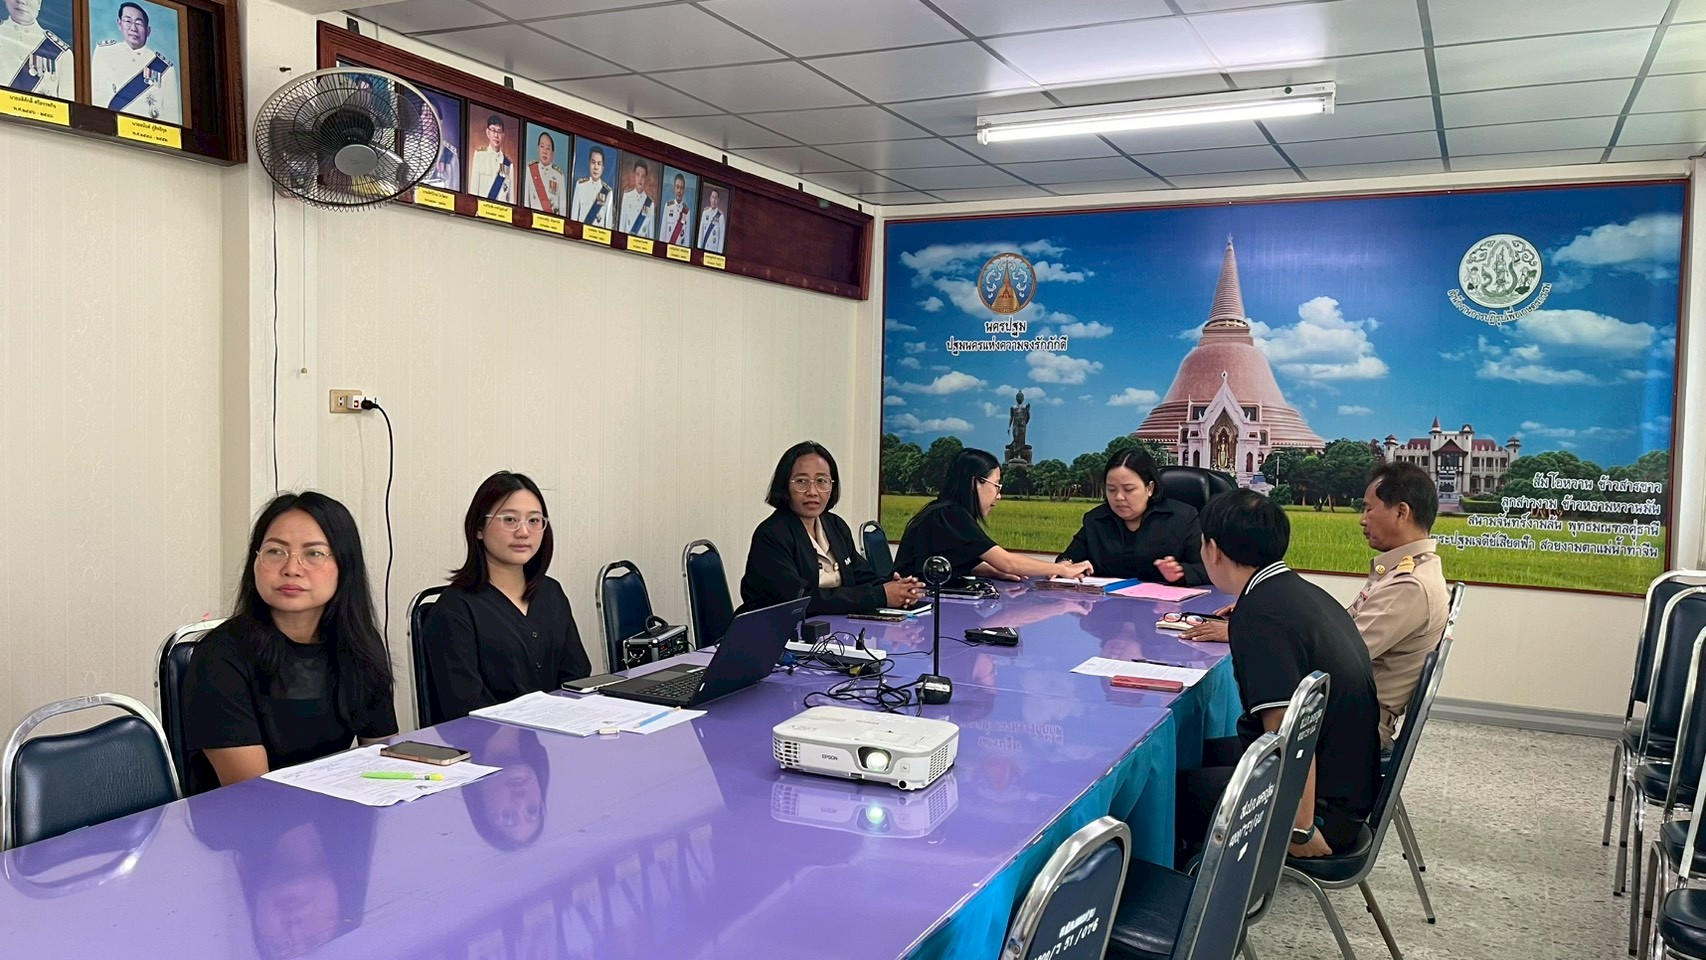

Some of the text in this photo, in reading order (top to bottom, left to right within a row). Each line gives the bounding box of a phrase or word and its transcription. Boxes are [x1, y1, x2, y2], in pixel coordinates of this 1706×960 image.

[985, 315, 1027, 337] นครปฐม
[946, 336, 1068, 355] ปฐมนครแห่งความจงรักภักดี
[1533, 471, 1662, 493] ส้มโอหวาน ข้าวสารขาว
[1501, 494, 1661, 515] ลูกสาวงาม ข้าวหลามหวานมัน
[1568, 519, 1661, 540] พุทธมณฑลคู่ธานี
[1540, 536, 1658, 557] สวยงามตาแม่น้ำท่าจีน
[821, 753, 838, 761] EPSON
